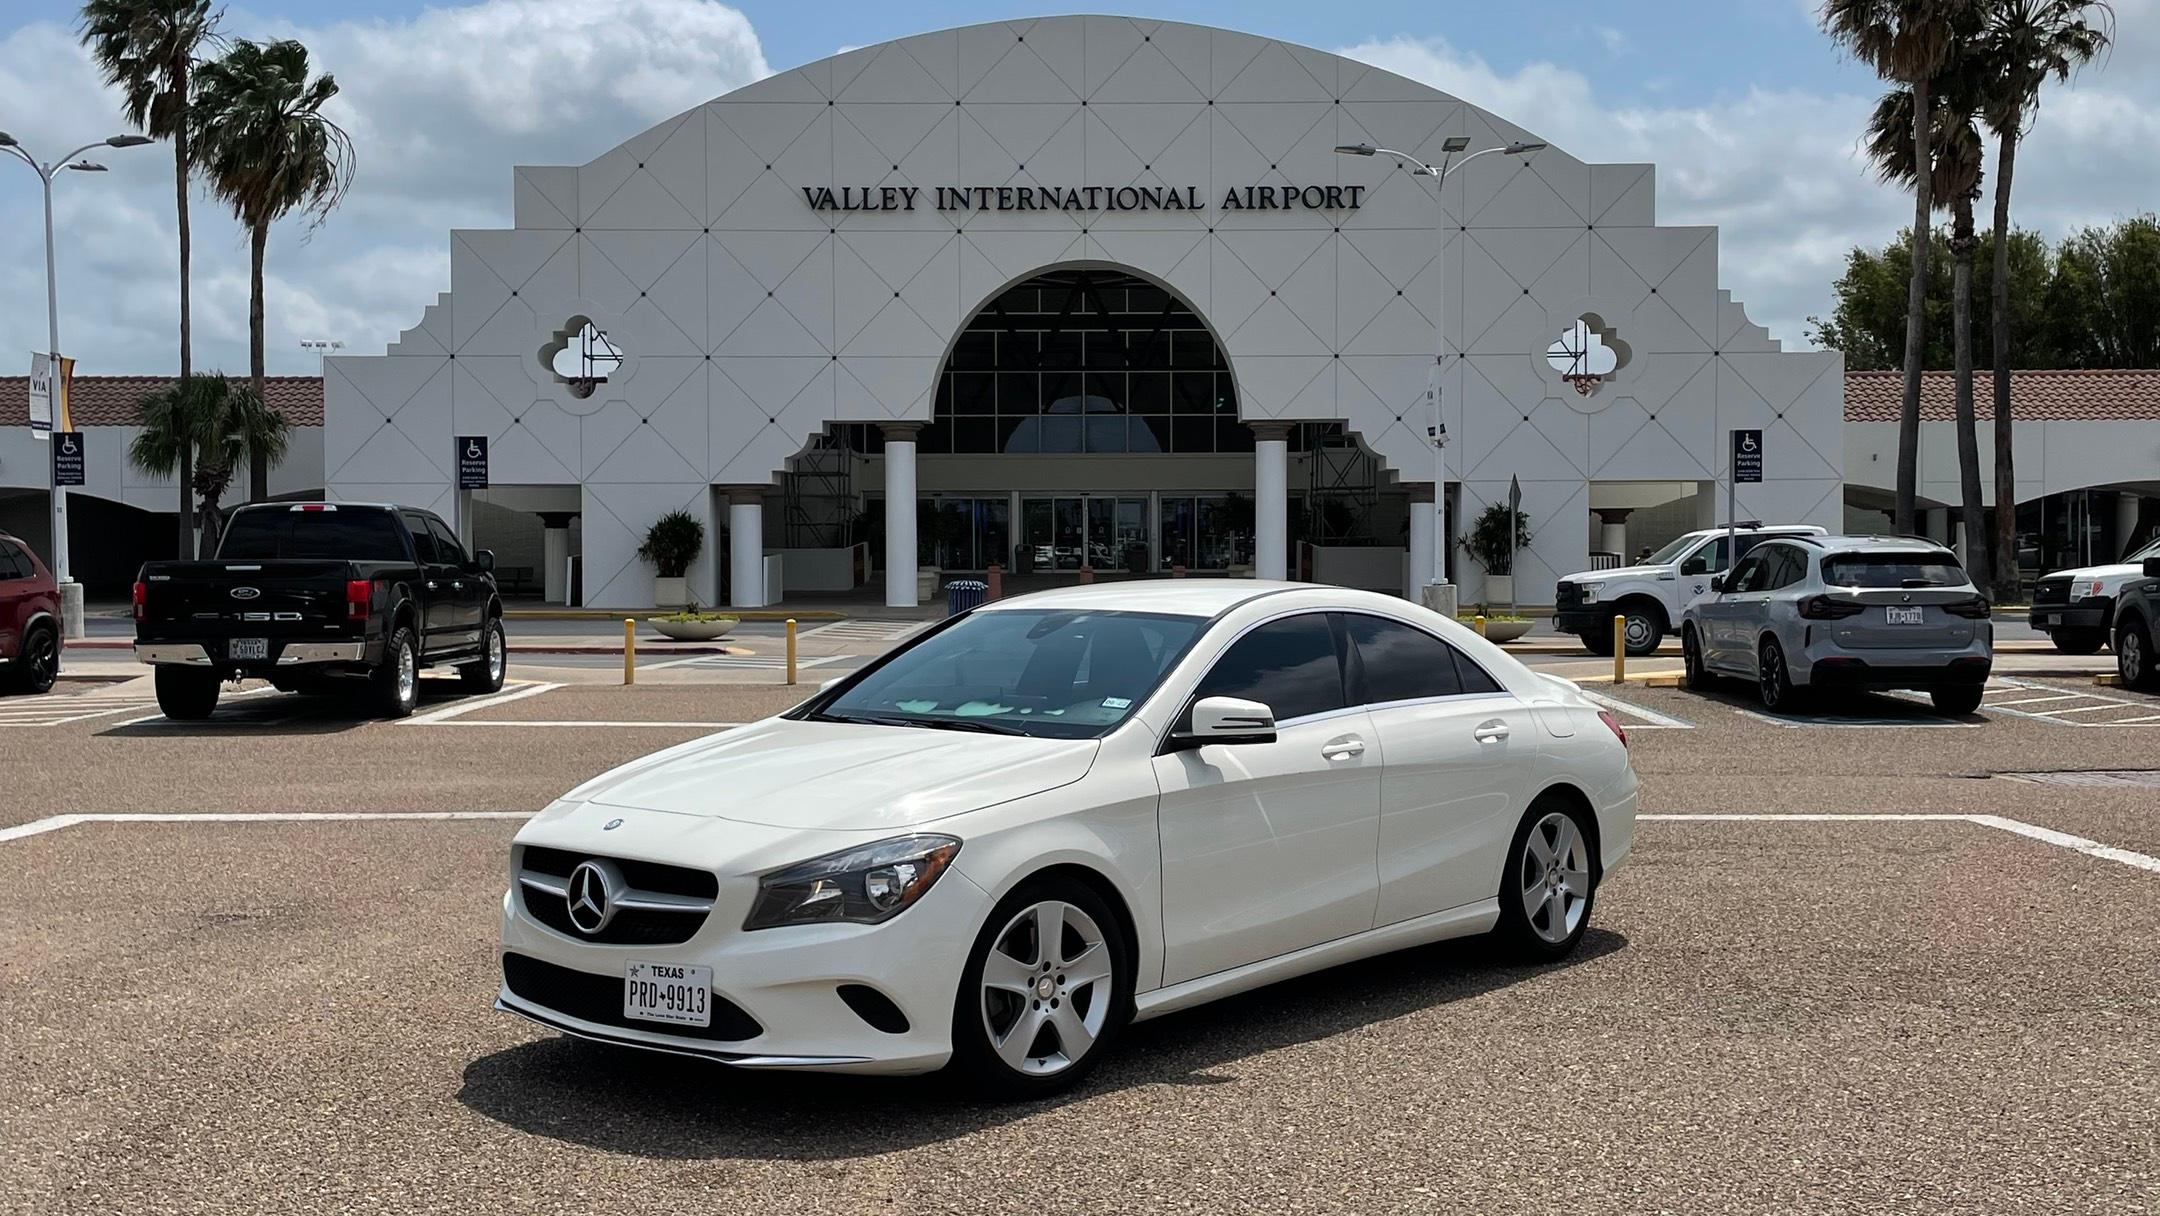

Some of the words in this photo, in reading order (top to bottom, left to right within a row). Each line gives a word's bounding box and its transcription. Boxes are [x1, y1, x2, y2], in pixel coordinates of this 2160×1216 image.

[802, 186, 919, 211] VALLEY
[935, 186, 1205, 211] INTERNATIONAL
[1221, 185, 1366, 210] AIRPORT
[651, 965, 684, 979] TEXAS
